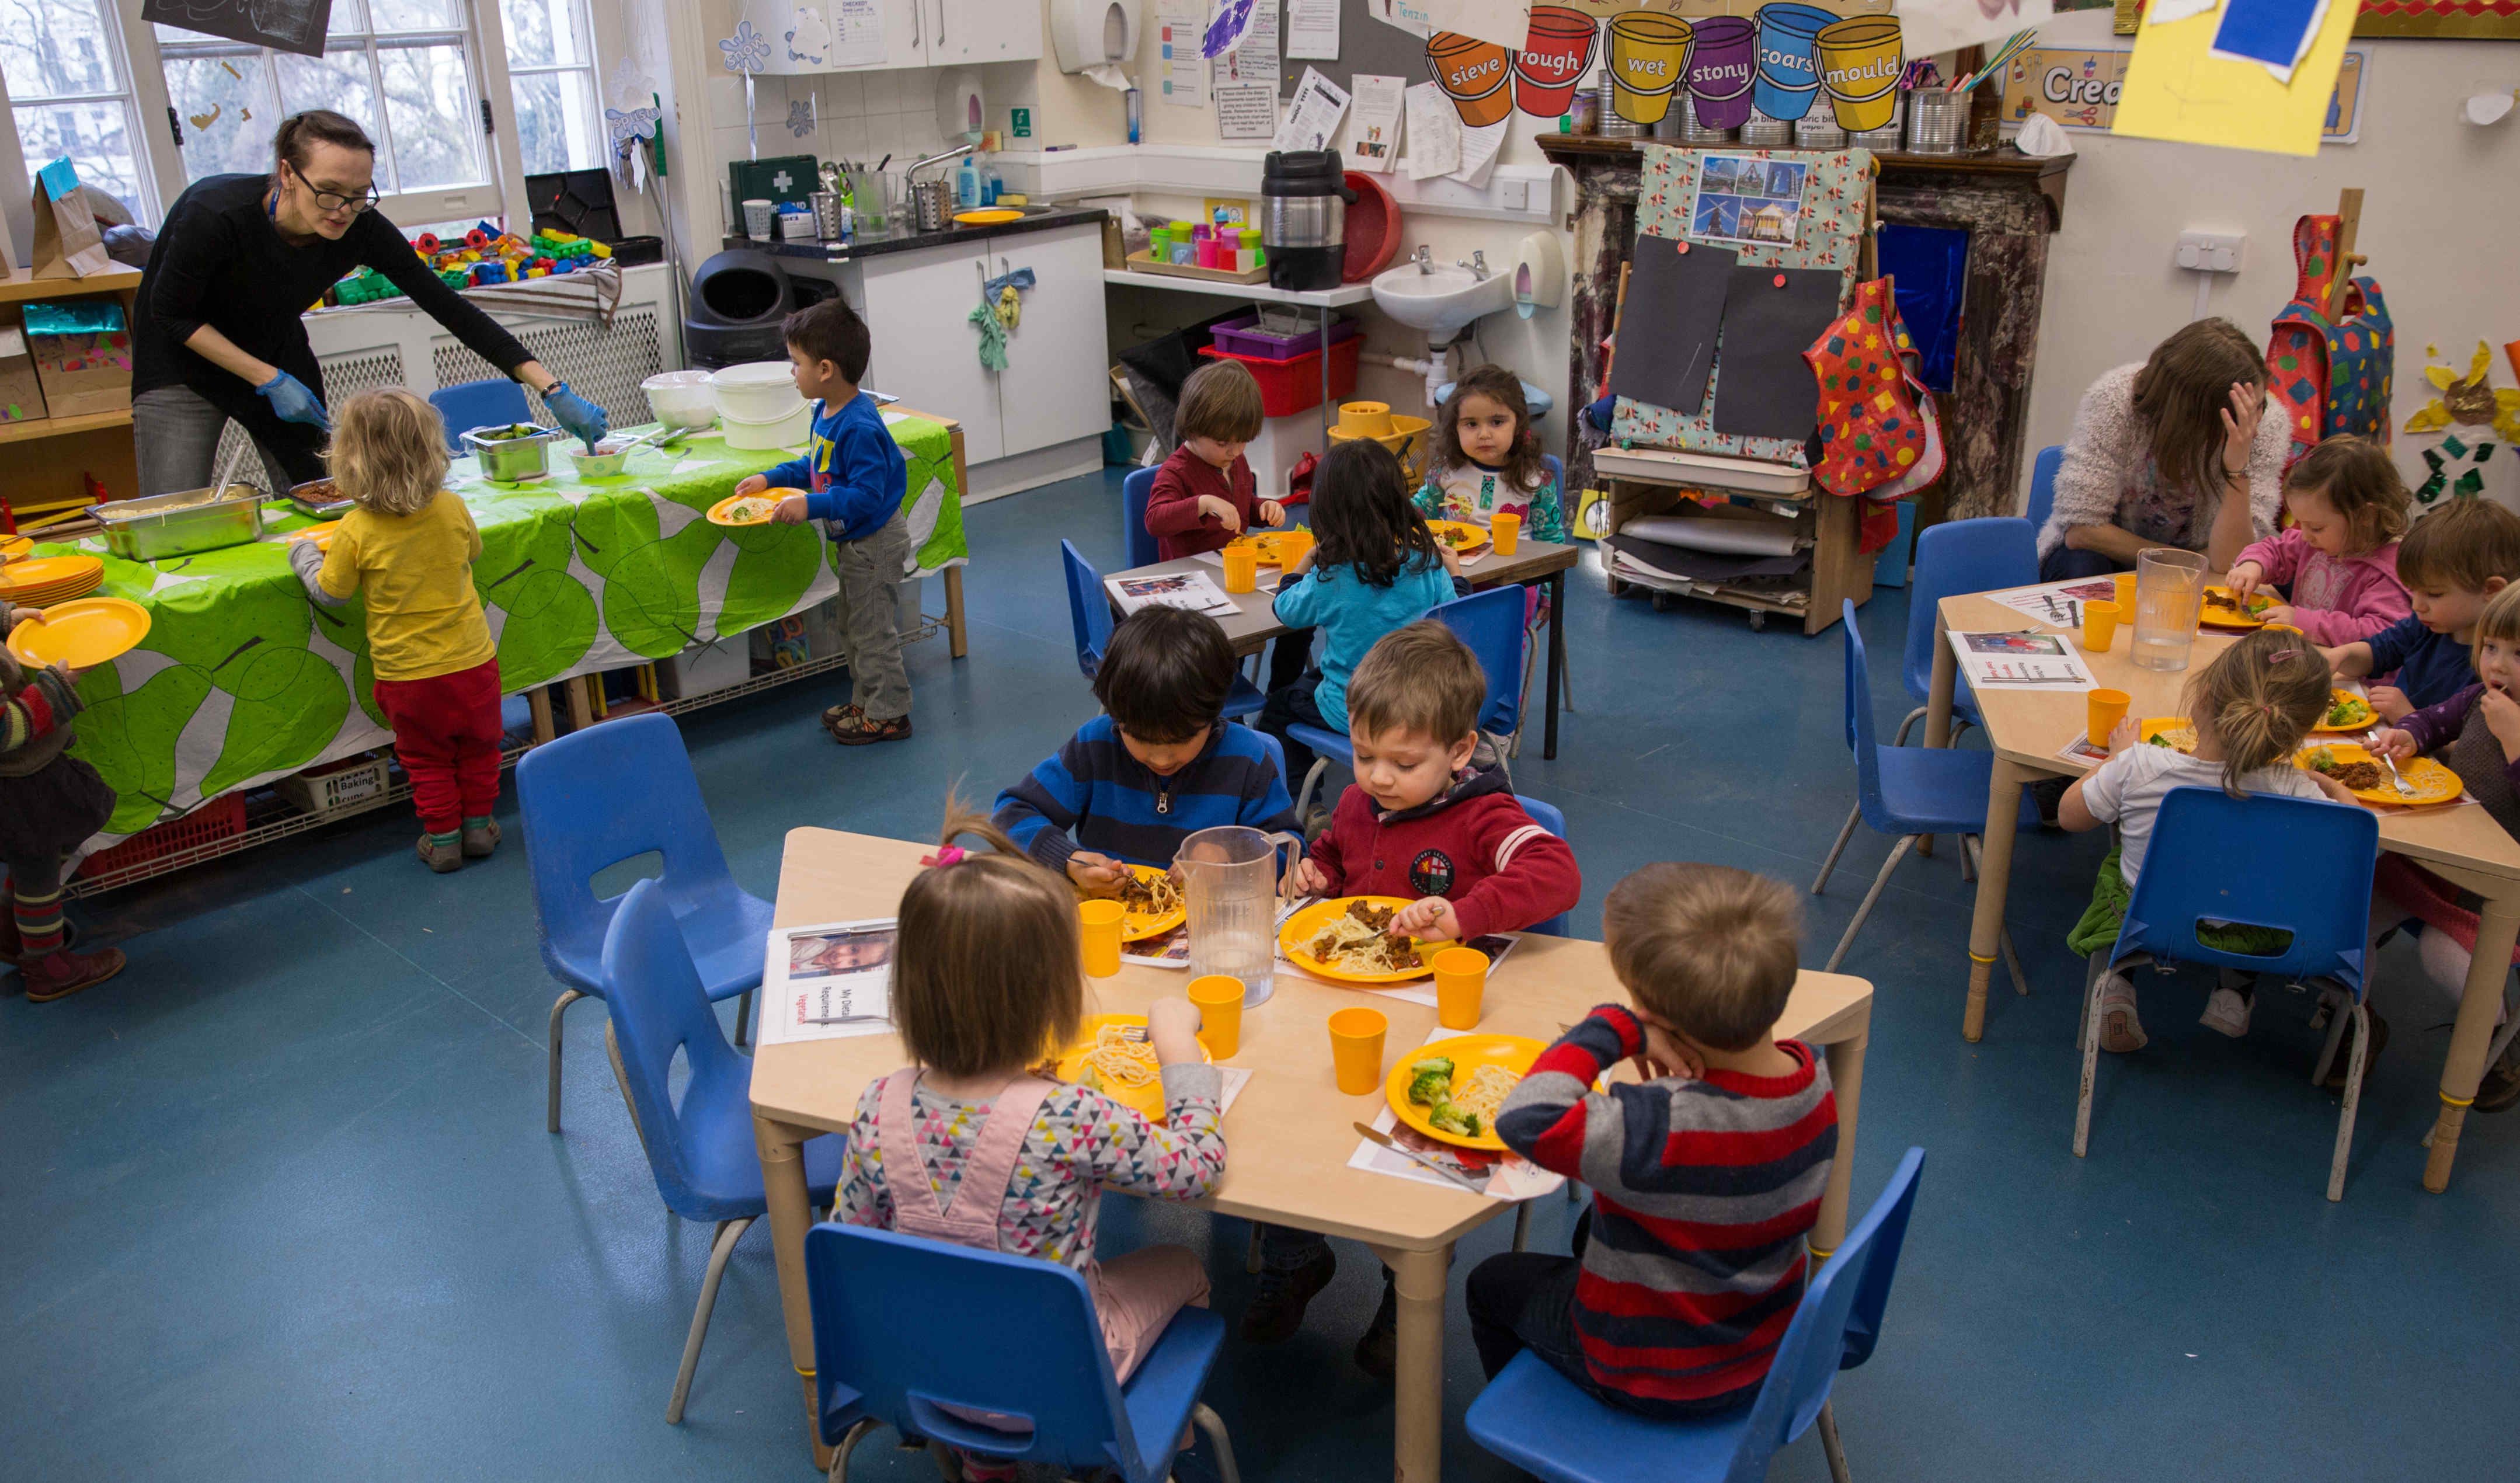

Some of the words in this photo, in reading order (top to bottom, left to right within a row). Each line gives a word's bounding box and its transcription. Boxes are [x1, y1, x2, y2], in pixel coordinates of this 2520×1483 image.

[1398, 1, 1429, 22] Tenzin
[1451, 58, 1501, 86] sieve
[1519, 50, 1579, 76] rough
[1627, 58, 1666, 76] wet
[1693, 62, 1749, 84] stony
[1761, 48, 1814, 73] coars
[1826, 55, 1899, 84] mould
[2044, 65, 2124, 105] Crea
[341, 777, 374, 790] Baking
[840, 989, 852, 998] My
[796, 994, 809, 1025] Vegetarian
[819, 986, 831, 1028] Requiremes:
